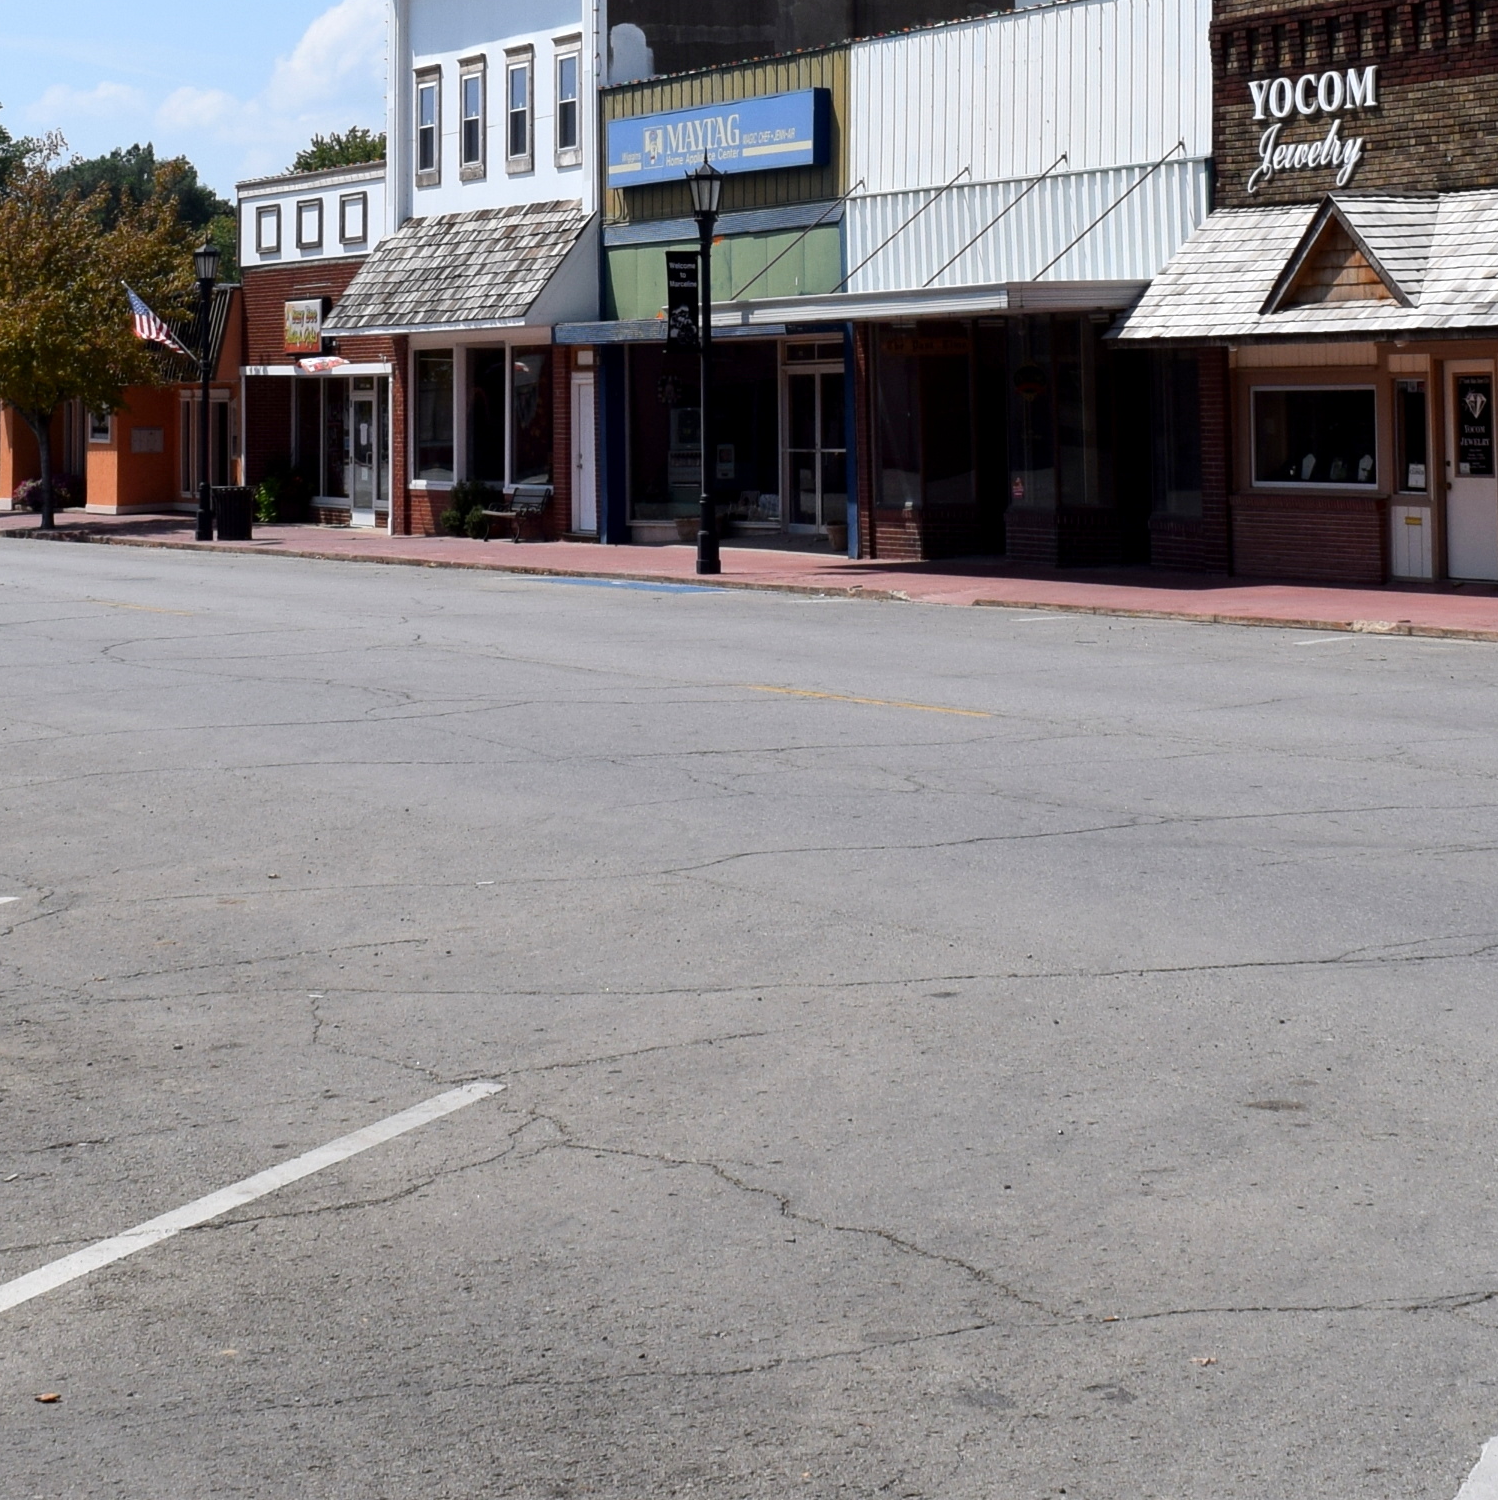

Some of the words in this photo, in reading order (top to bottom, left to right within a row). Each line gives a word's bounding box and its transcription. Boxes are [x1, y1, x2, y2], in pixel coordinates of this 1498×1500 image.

[1248, 65, 1379, 120] YOCOM
[666, 114, 740, 155] MAYTAG
[666, 155, 684, 167] Home
[718, 148, 740, 160] Center
[1248, 119, 1364, 194] Jewelry
[669, 280, 697, 288] Marceline
[679, 271, 687, 279] to
[1460, 437, 1490, 447] JEWELRY
